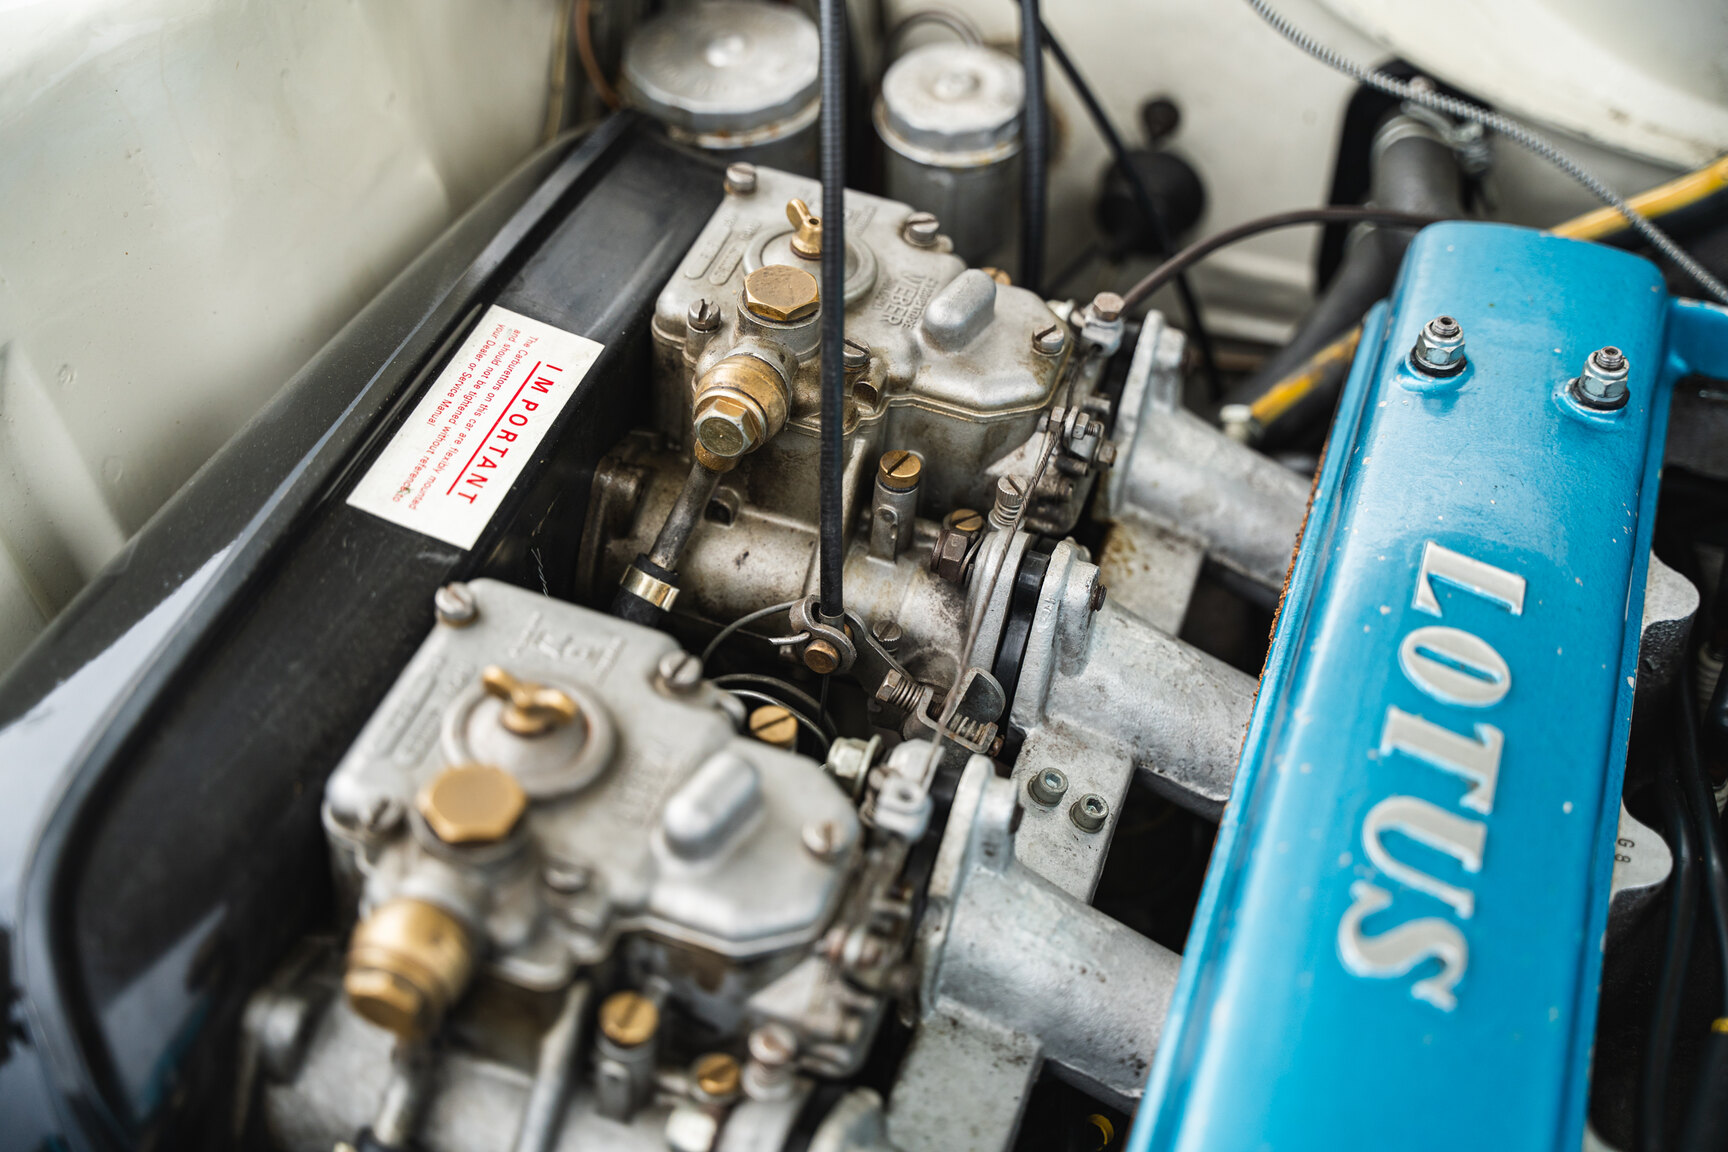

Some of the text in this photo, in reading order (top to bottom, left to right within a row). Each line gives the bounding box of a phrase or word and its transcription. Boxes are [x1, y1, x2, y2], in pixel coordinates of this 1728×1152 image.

[507, 329, 520, 343] and
[490, 343, 511, 366] should
[427, 324, 504, 426] your Dealer or Service Manual
[473, 379, 487, 390] be
[481, 366, 494, 379] not
[409, 336, 538, 510] The Carburettors on this car are flexibly mounted
[448, 391, 477, 425] tightened
[426, 426, 451, 454] without
[458, 364, 563, 504] IMPORTANT
[1337, 540, 1527, 1012] LOTUS
